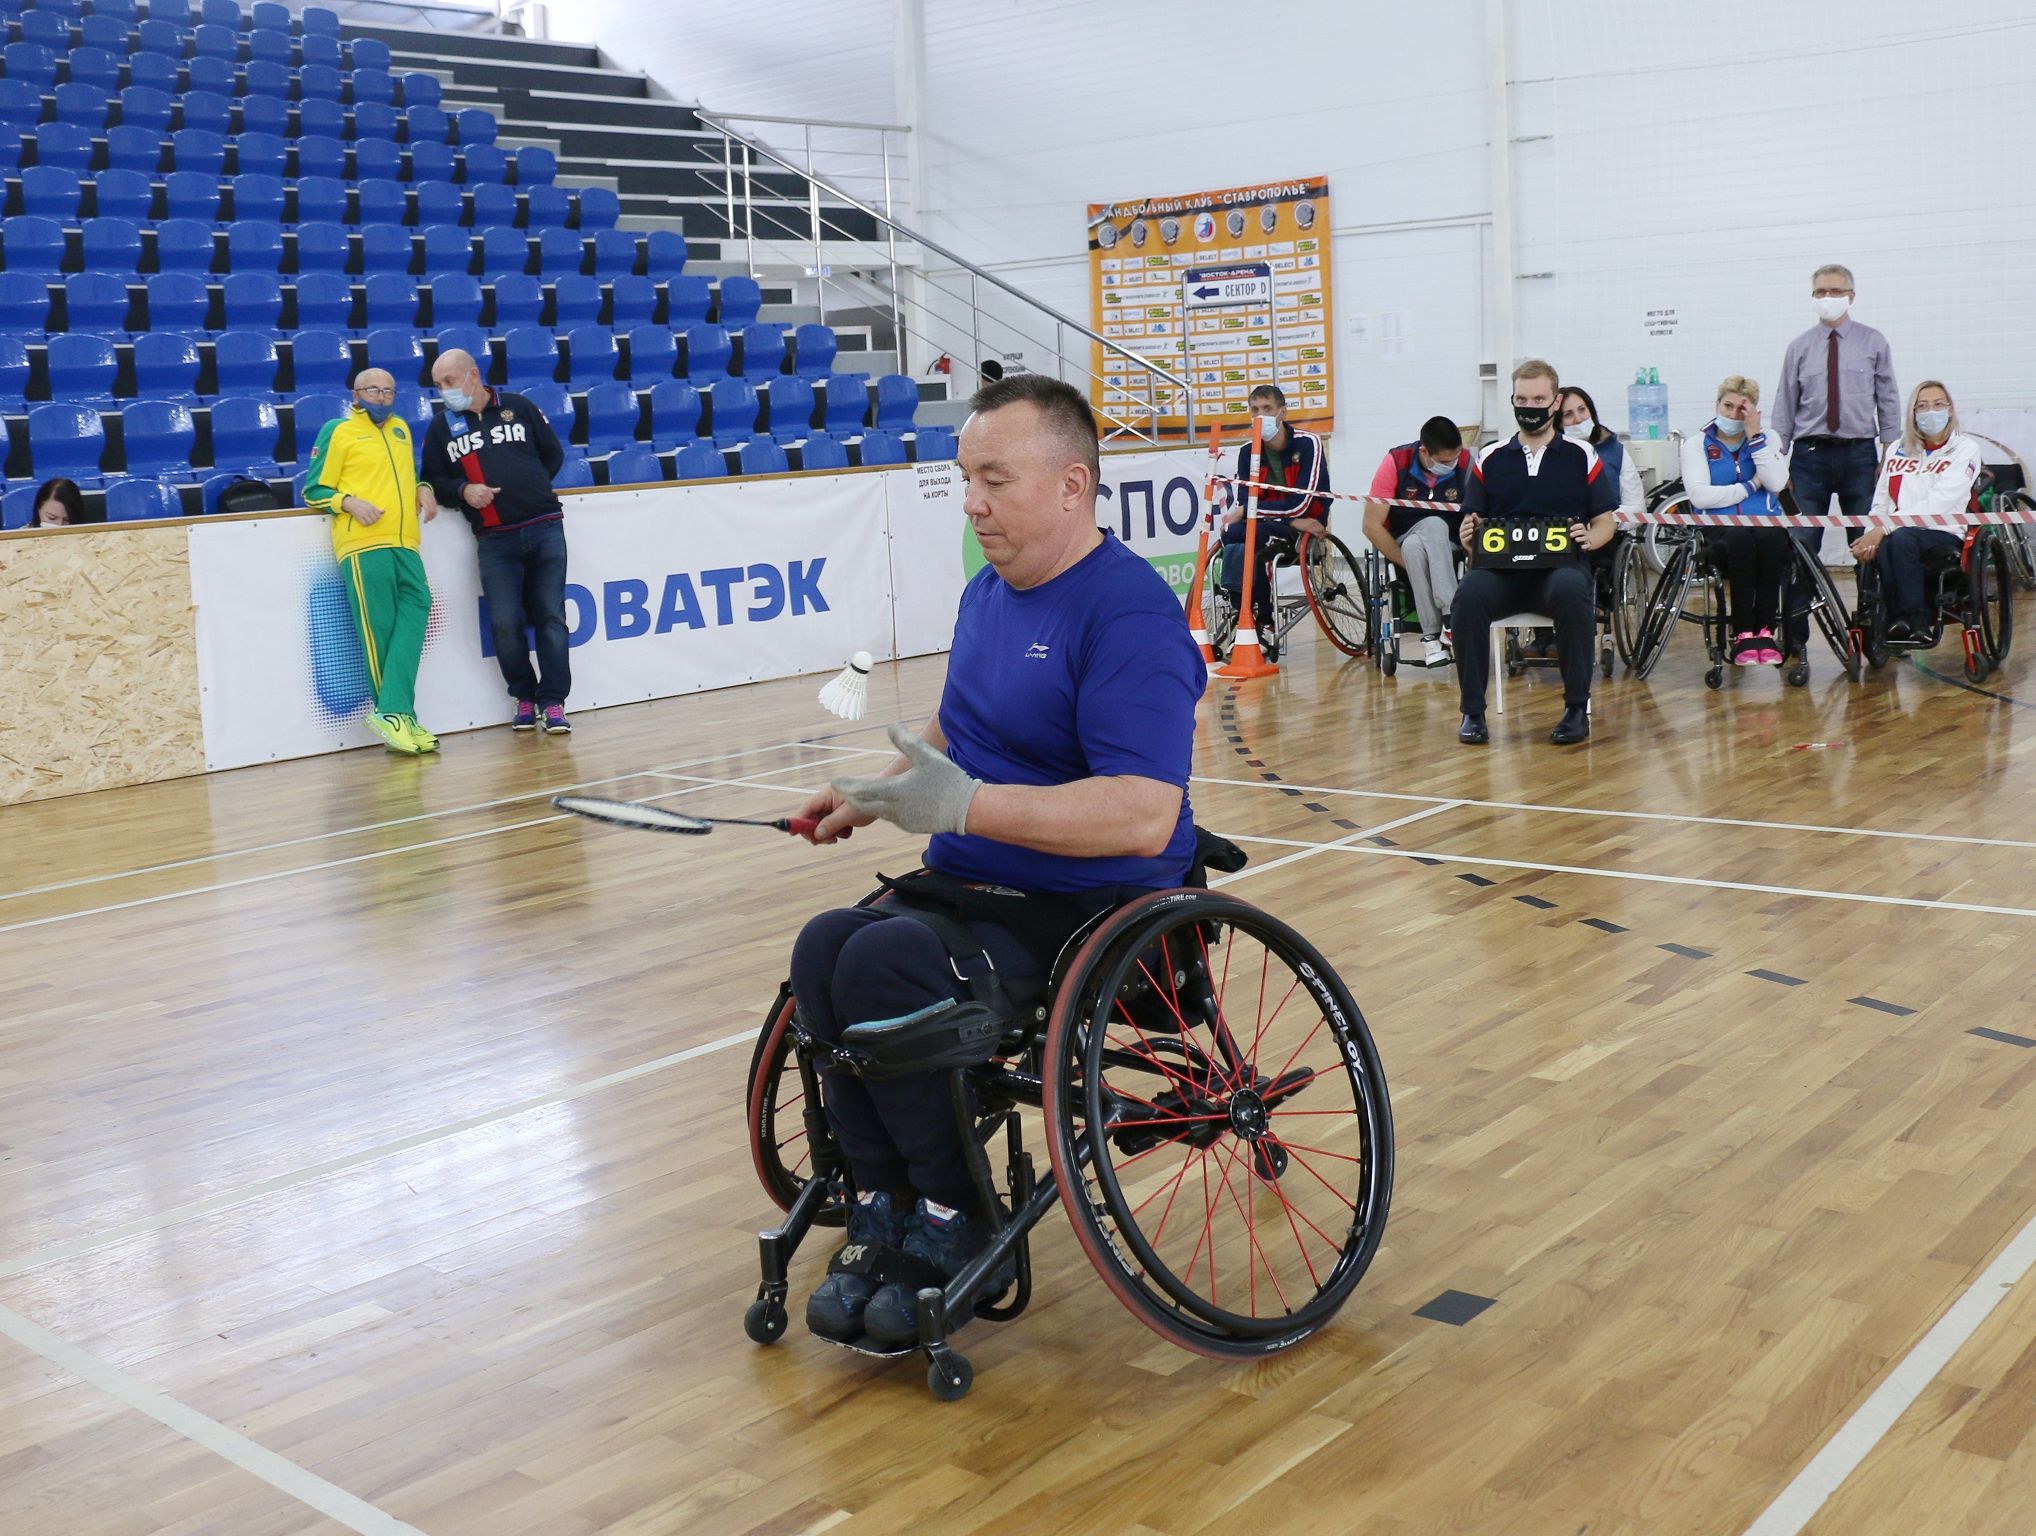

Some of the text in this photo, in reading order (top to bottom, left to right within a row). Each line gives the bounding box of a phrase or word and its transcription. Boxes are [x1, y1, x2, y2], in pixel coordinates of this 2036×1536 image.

[1103, 200, 1182, 218] АНДБОЛЬНЫЙ
[1185, 197, 1212, 209] КЛУБ
[1225, 282, 1256, 297] СЕКТОР
[1260, 282, 1267, 295] D
[917, 464, 951, 475] МЕСТО СБОРА
[919, 477, 951, 488] ДЛЯ ВЫХОДА
[923, 490, 949, 500] НА КОРТЫ
[1482, 527, 1568, 553] 6 0 0 5
